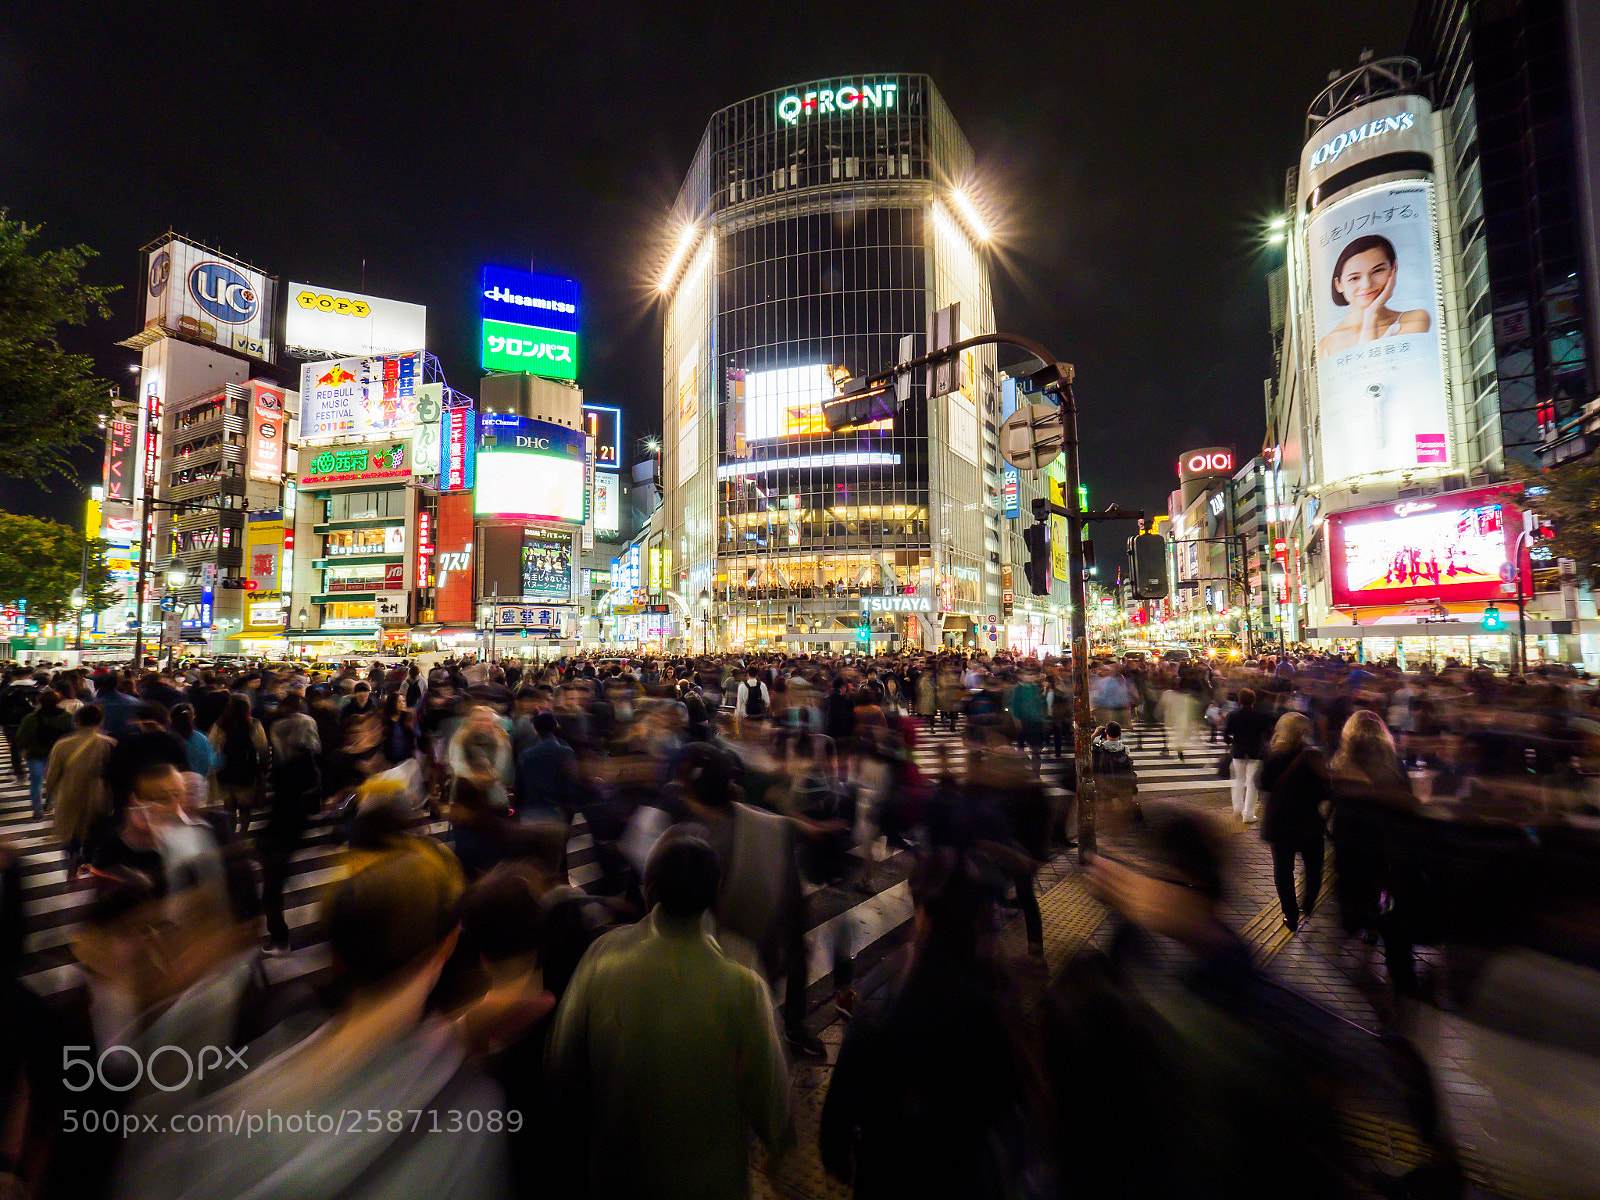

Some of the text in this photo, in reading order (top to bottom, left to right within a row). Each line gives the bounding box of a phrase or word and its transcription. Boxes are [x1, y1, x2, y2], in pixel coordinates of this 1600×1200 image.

[779, 84, 897, 124] QFRONT
[197, 269, 256, 314] UC
[302, 296, 366, 313] TOPY
[484, 286, 575, 313] Hisamitsu
[237, 340, 264, 354] VISA
[487, 335, 572, 363] サロンパス
[316, 387, 354, 399] RED BULL
[321, 399, 349, 409] MUSIC
[315, 409, 354, 421] FESTIVAL
[516, 436, 549, 450] DHC
[335, 455, 368, 473] 西村
[1005, 471, 1017, 510] SEIBU
[330, 544, 384, 555] Euphoria
[386, 564, 403, 578] JTB
[861, 598, 931, 611] TSUTAYA
